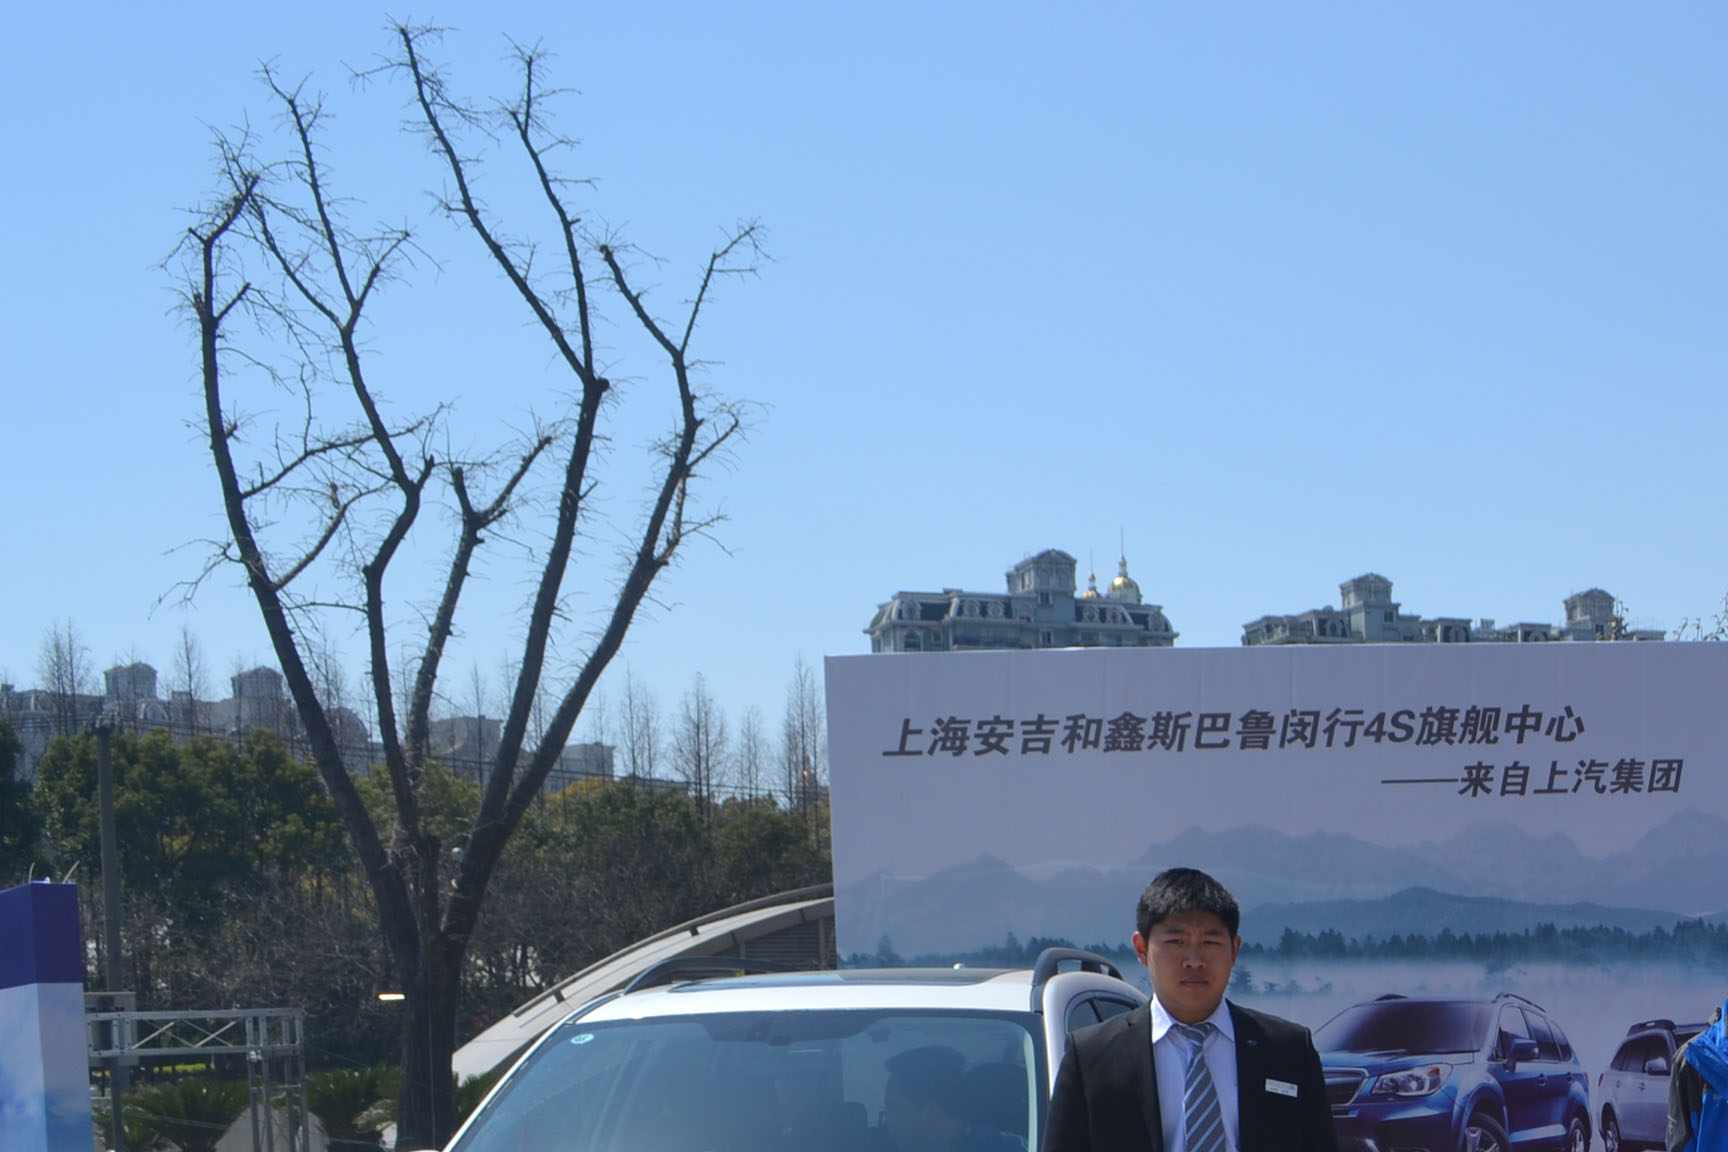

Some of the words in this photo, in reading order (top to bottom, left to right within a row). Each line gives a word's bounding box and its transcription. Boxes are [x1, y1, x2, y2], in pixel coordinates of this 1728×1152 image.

[882, 704, 1585, 757] 上海安吉和鑫斯巴鲁闵行4S旗舰中心
